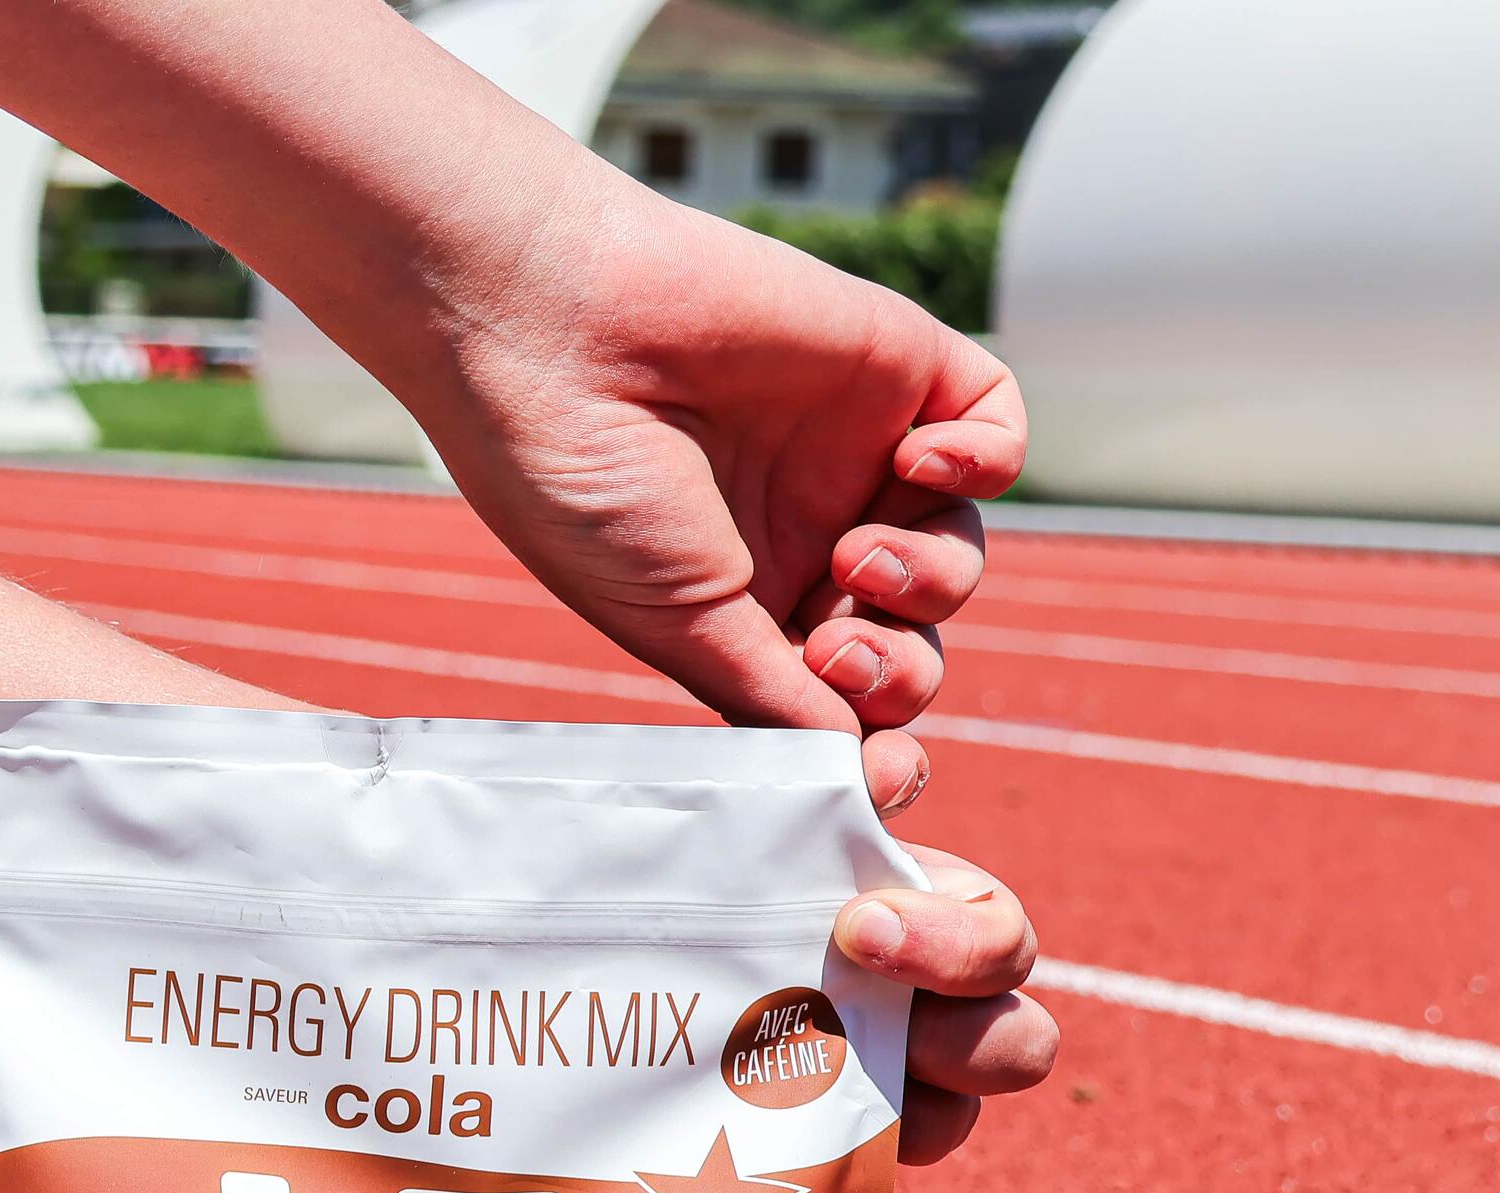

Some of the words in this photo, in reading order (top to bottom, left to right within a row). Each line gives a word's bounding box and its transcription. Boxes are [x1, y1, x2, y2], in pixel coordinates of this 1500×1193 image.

[124, 967, 373, 1060] ENERGY
[384, 987, 572, 1068] DRINK
[586, 991, 701, 1067] MIX
[753, 1002, 809, 1042] AVEC
[732, 1038, 833, 1087] CAFÉINE
[243, 1083, 310, 1106] SAVEUR
[324, 1074, 493, 1138] cola
